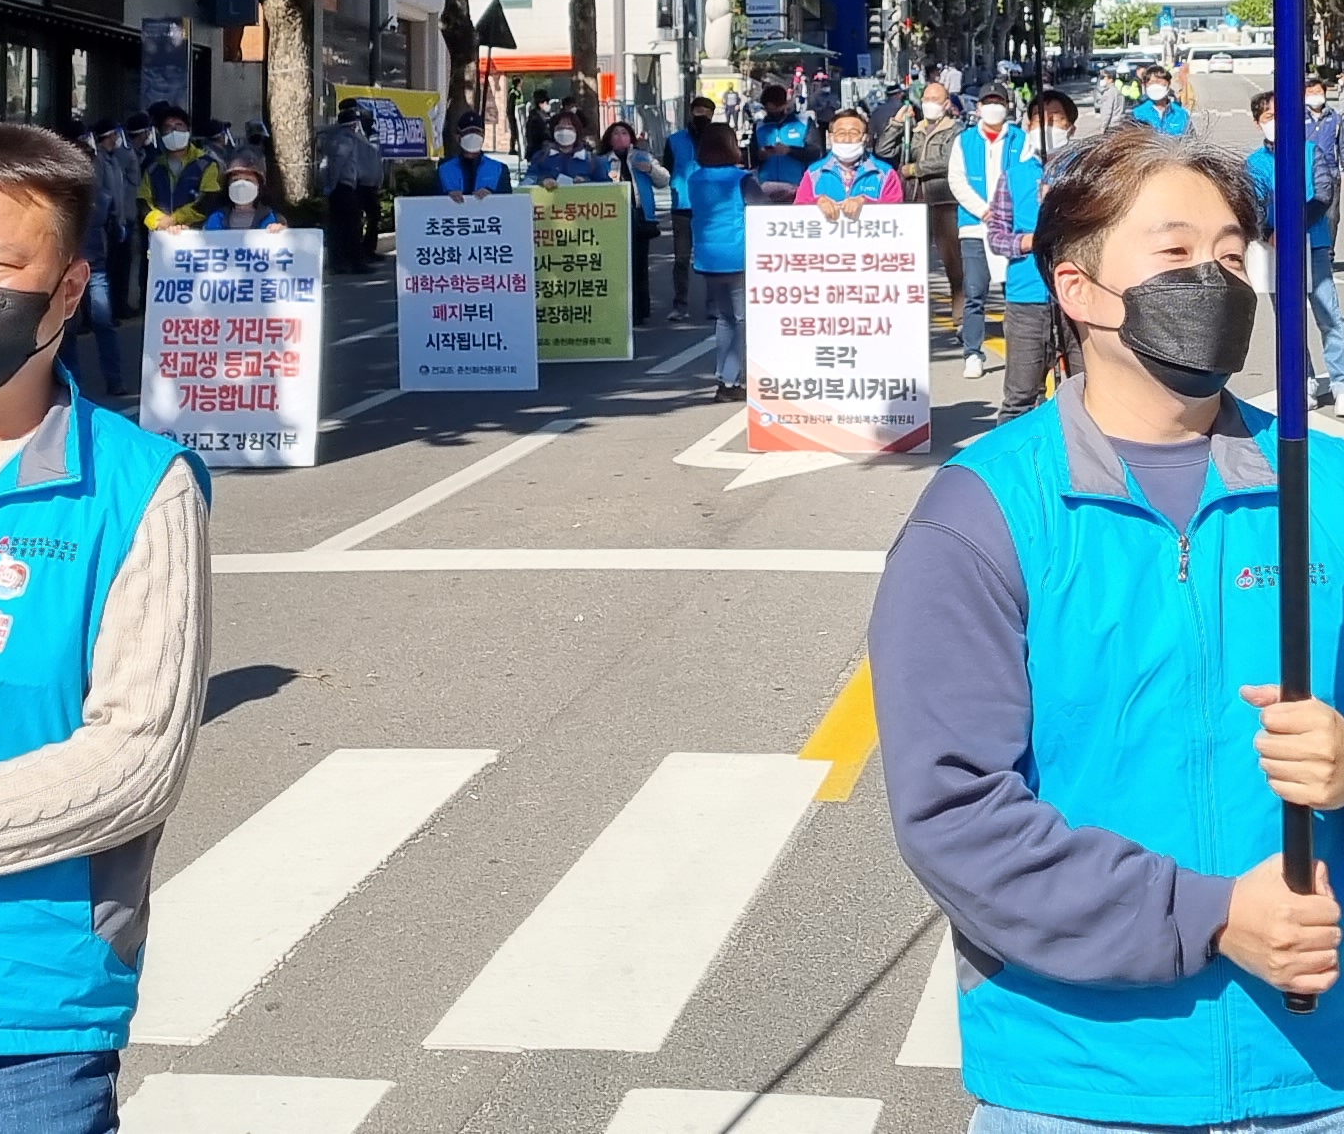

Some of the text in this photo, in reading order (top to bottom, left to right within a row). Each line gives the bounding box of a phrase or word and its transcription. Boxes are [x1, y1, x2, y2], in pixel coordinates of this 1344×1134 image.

[551, 202, 618, 221] 노동자이고
[425, 216, 503, 237] 초중등교육
[765, 218, 904, 239] 32년을 기다렸다.
[174, 247, 295, 273] 학급당 학생 수
[415, 244, 514, 266] 정상화 시작은
[756, 252, 916, 273] 국가폭력으로 희생된
[153, 277, 316, 304] 20명 이하로 줄이면
[405, 273, 527, 294] 대학수학능력시험
[748, 284, 926, 305] 1989년 해직교사 및
[432, 303, 493, 323] 폐지부터
[161, 317, 302, 345] 안전한 거리두기
[779, 316, 893, 337] 임용제외교사
[425, 331, 508, 352] 시작됩니다.
[158, 350, 301, 378] 전교생 등교수업
[814, 345, 859, 368] 즉각
[178, 384, 280, 412] 가능합니다.
[757, 377, 918, 402] 원상회복시켜라!
